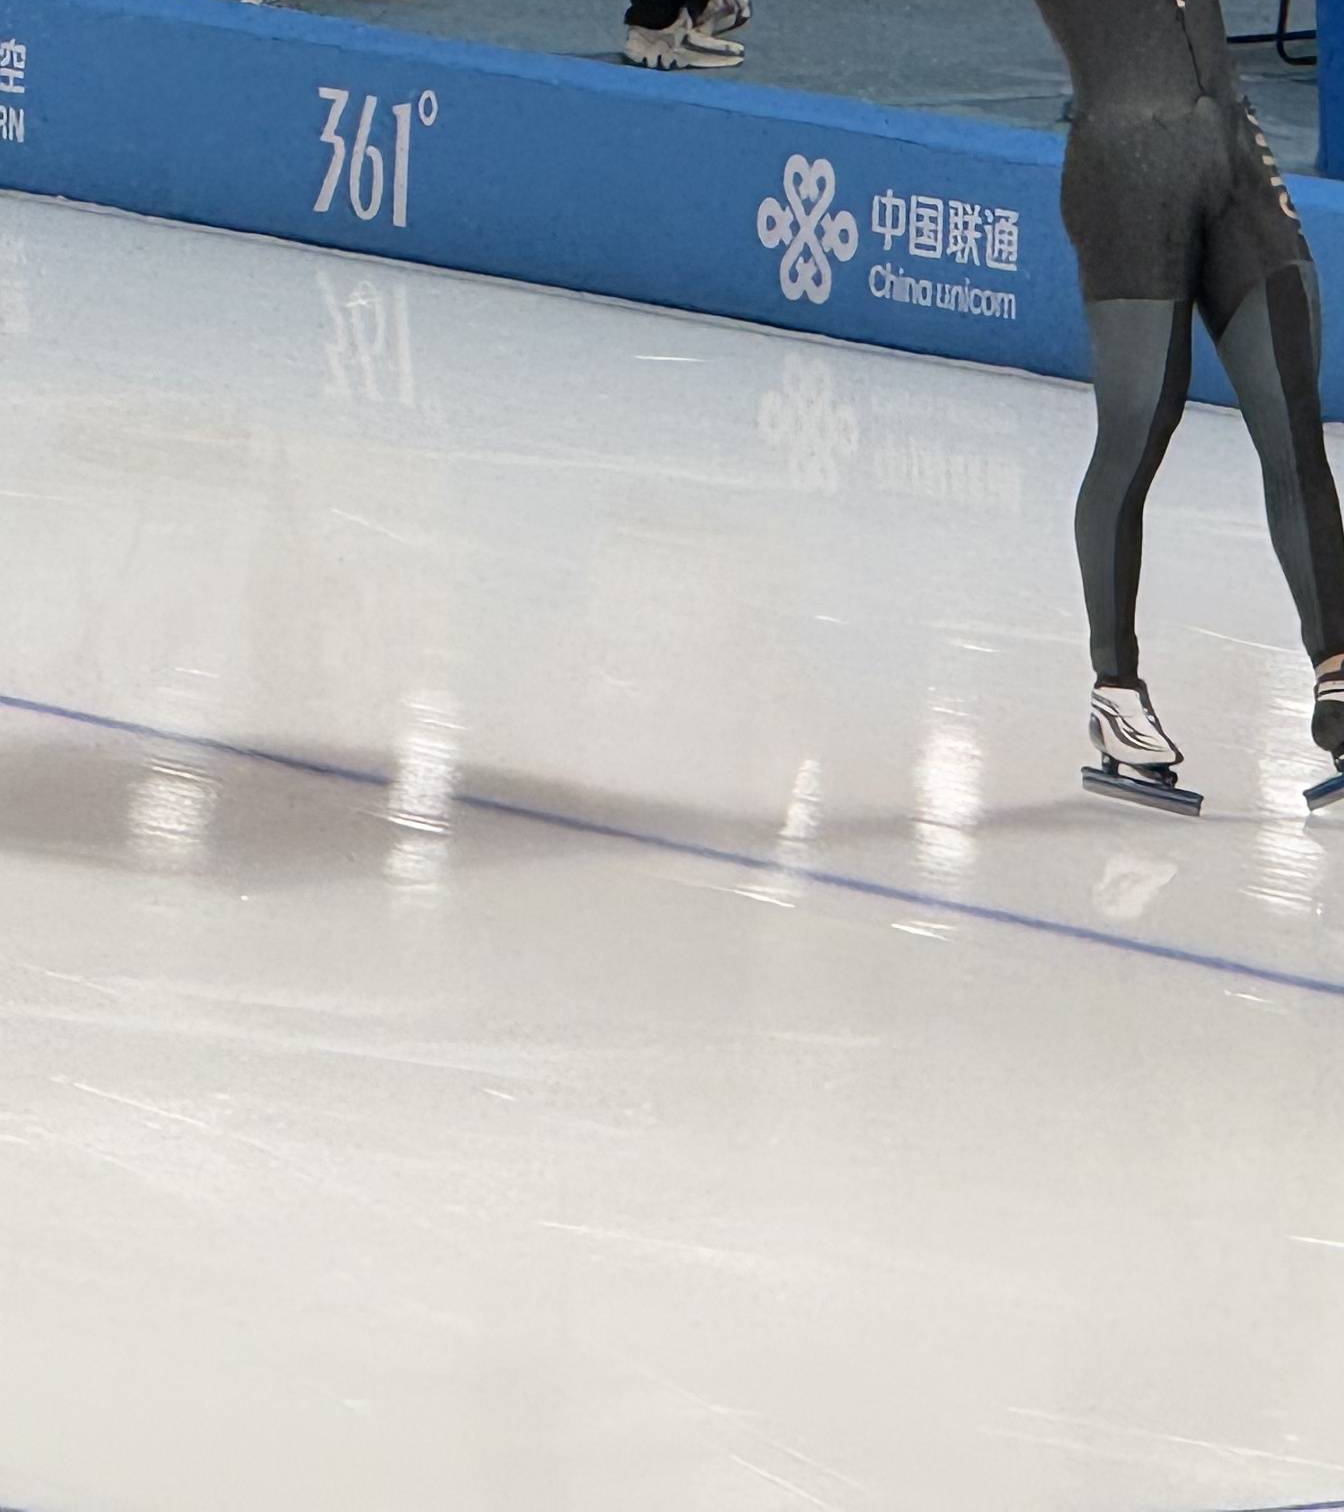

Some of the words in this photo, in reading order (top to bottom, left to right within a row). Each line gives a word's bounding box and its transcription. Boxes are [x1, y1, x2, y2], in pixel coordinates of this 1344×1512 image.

[313, 87, 438, 228] 361°
[871, 188, 1019, 271] 中国联通
[868, 262, 932, 307] China
[935, 277, 1016, 320] unicom
